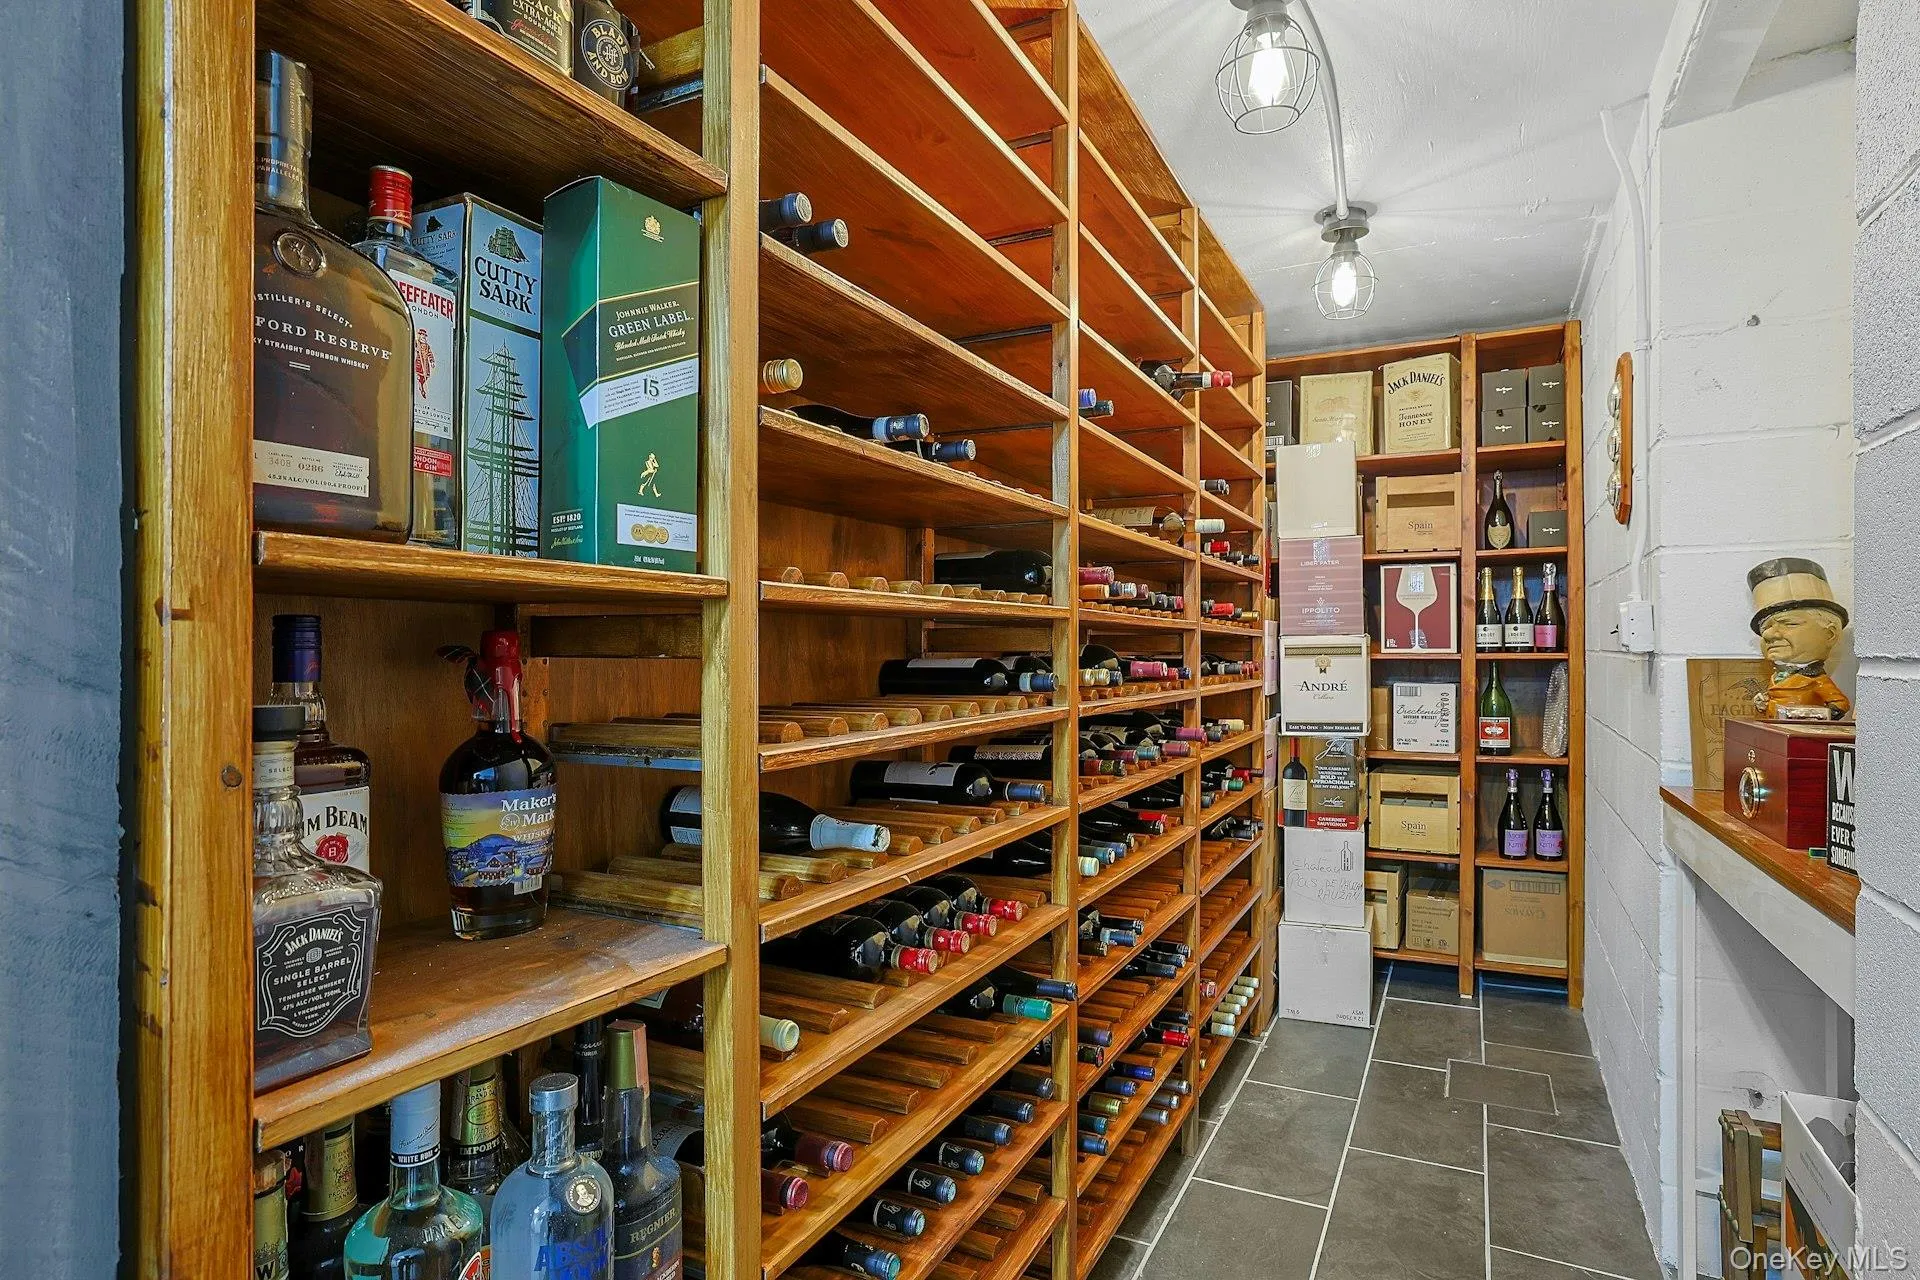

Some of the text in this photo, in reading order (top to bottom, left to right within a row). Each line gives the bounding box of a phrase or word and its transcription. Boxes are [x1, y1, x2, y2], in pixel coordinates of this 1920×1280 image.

[592, 25, 629, 54] BLADE
[588, 51, 629, 84] AND BOW
[474, 256, 538, 295] CUTTY
[316, 305, 350, 328] SELECT
[615, 306, 649, 321] JOHNNIE
[608, 318, 652, 338] GREEN
[265, 339, 303, 354] STRAIGHT
[306, 349, 339, 363] BOURBON
[341, 357, 370, 370] WHISKEY
[315, 329, 391, 361] RESERVE
[643, 379, 659, 397] 15
[1388, 371, 1446, 394] JACK DANIEL'S
[1399, 417, 1434, 428] HONEY
[298, 463, 324, 473] 0286
[1408, 521, 1433, 532] Spain
[1302, 606, 1341, 614] IPPOLITO
[1299, 680, 1348, 692] ANDRÉ
[325, 804, 368, 838] BEAM
[1401, 820, 1427, 832] Spain
[1831, 826, 1850, 847] EVER
[284, 927, 344, 956] JACK DANIEL'S
[274, 957, 351, 985] SINGLE BARREL
[297, 972, 330, 988] SELECT
[278, 978, 346, 1003] TENNESSEE WHISKEY
[293, 1001, 331, 1017] LYNCHBURG
[398, 1150, 434, 1164] WHITE RUM
[629, 1207, 676, 1244] REGNIER
